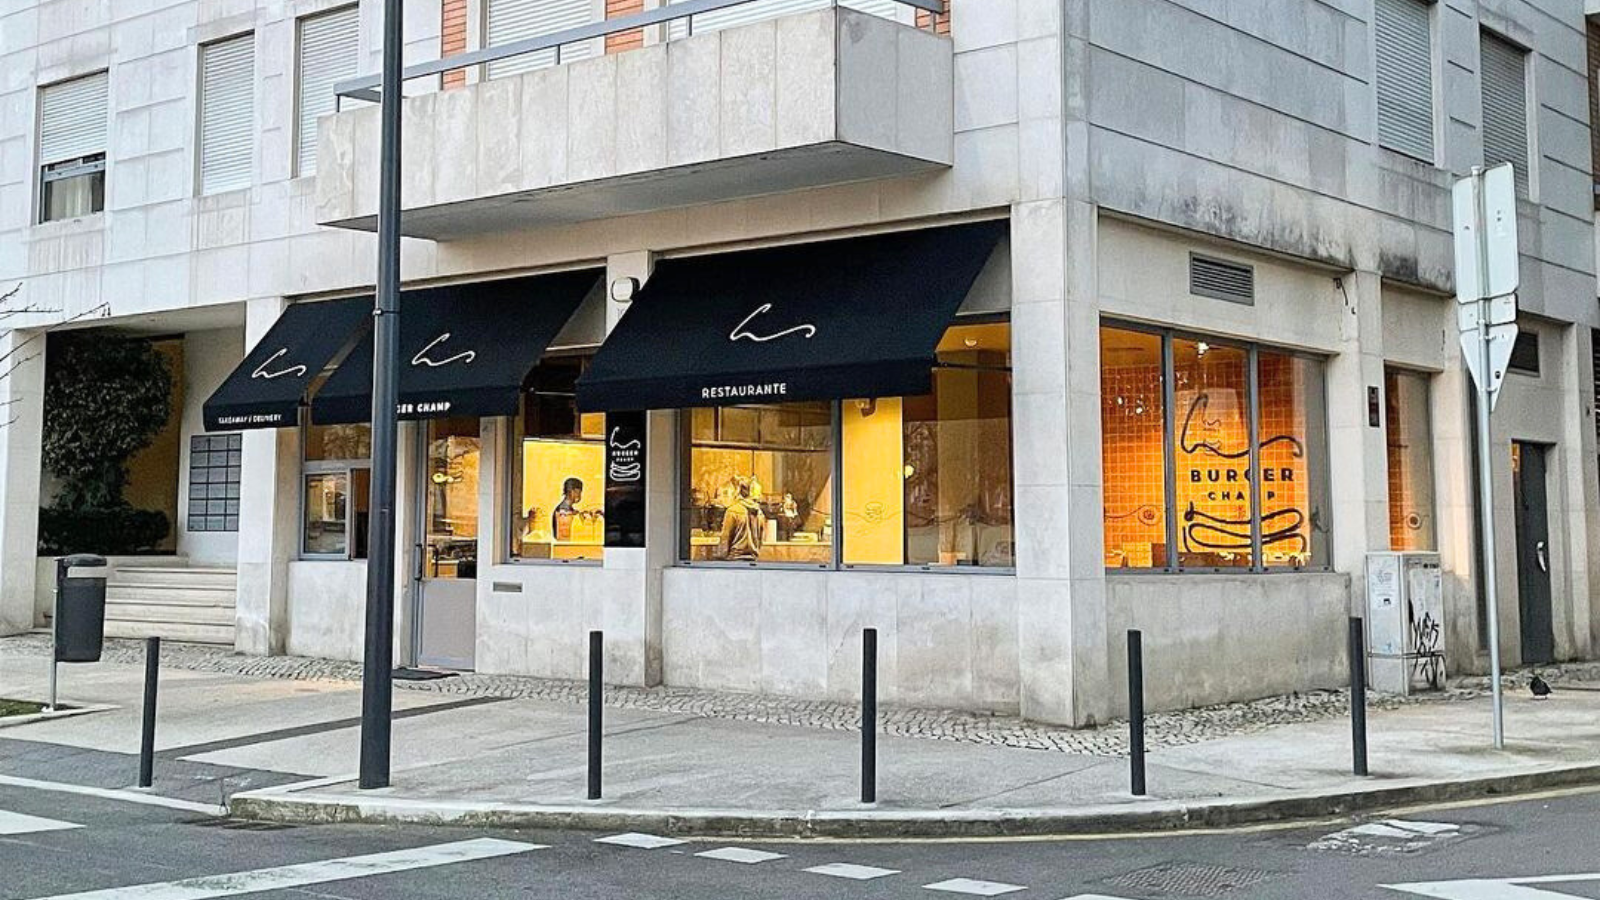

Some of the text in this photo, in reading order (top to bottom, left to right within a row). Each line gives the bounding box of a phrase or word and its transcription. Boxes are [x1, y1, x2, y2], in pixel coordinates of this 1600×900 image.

[702, 383, 786, 398] RESTAURANTE
[417, 402, 450, 413] CHAMP
[1208, 491, 1275, 500] CHAP
